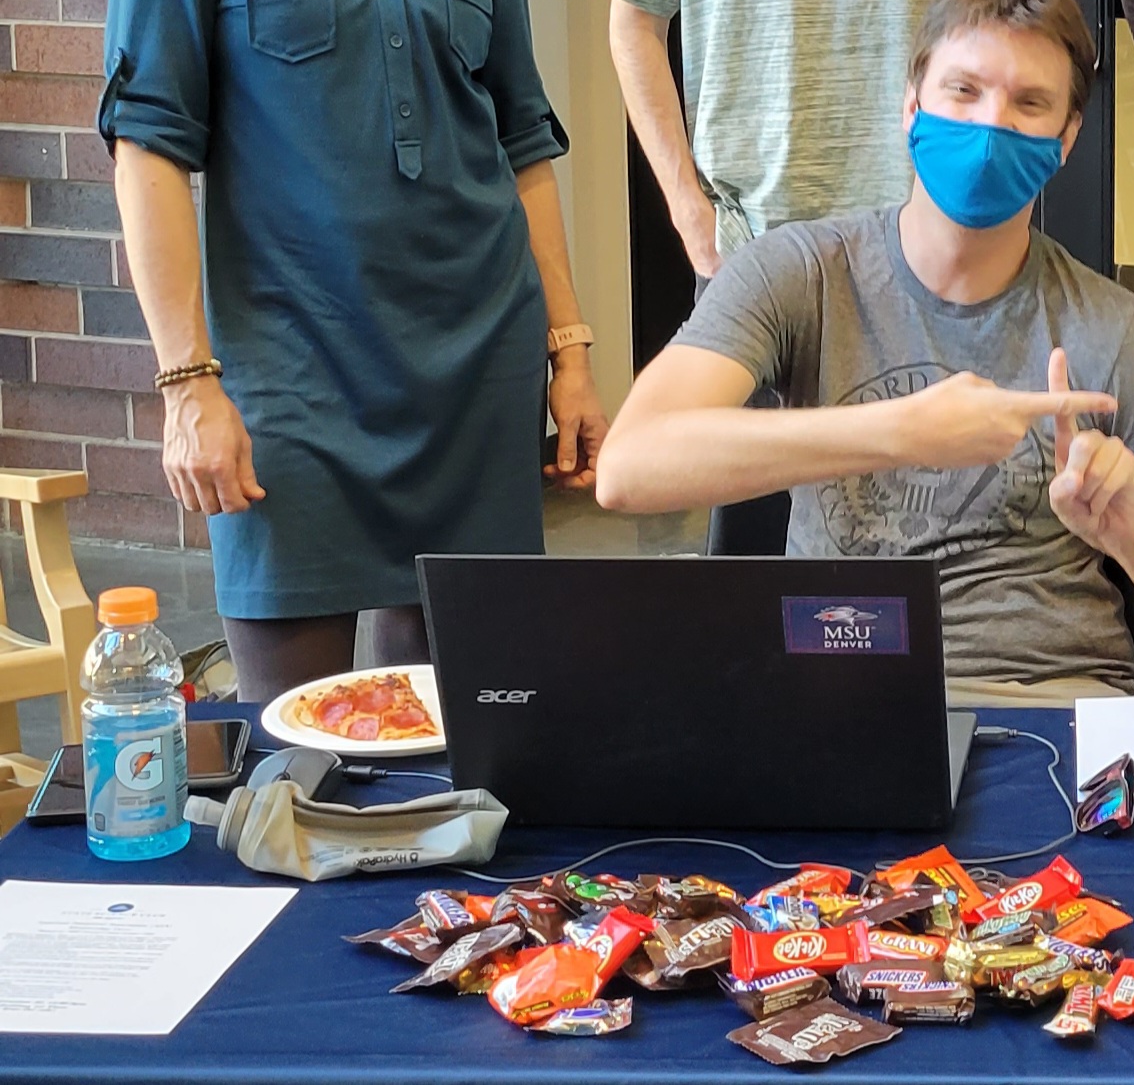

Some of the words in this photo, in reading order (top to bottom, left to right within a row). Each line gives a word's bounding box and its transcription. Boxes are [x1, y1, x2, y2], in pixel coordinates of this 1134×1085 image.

[824, 626, 871, 640] MSU
[824, 640, 872, 649] DENVER
[477, 689, 537, 704] acer
[115, 737, 163, 791] G
[354, 852, 407, 868] HydraPak
[779, 933, 826, 957] KitKat
[867, 971, 924, 983] SNICKERS
[1064, 984, 1094, 1016] TWIX
